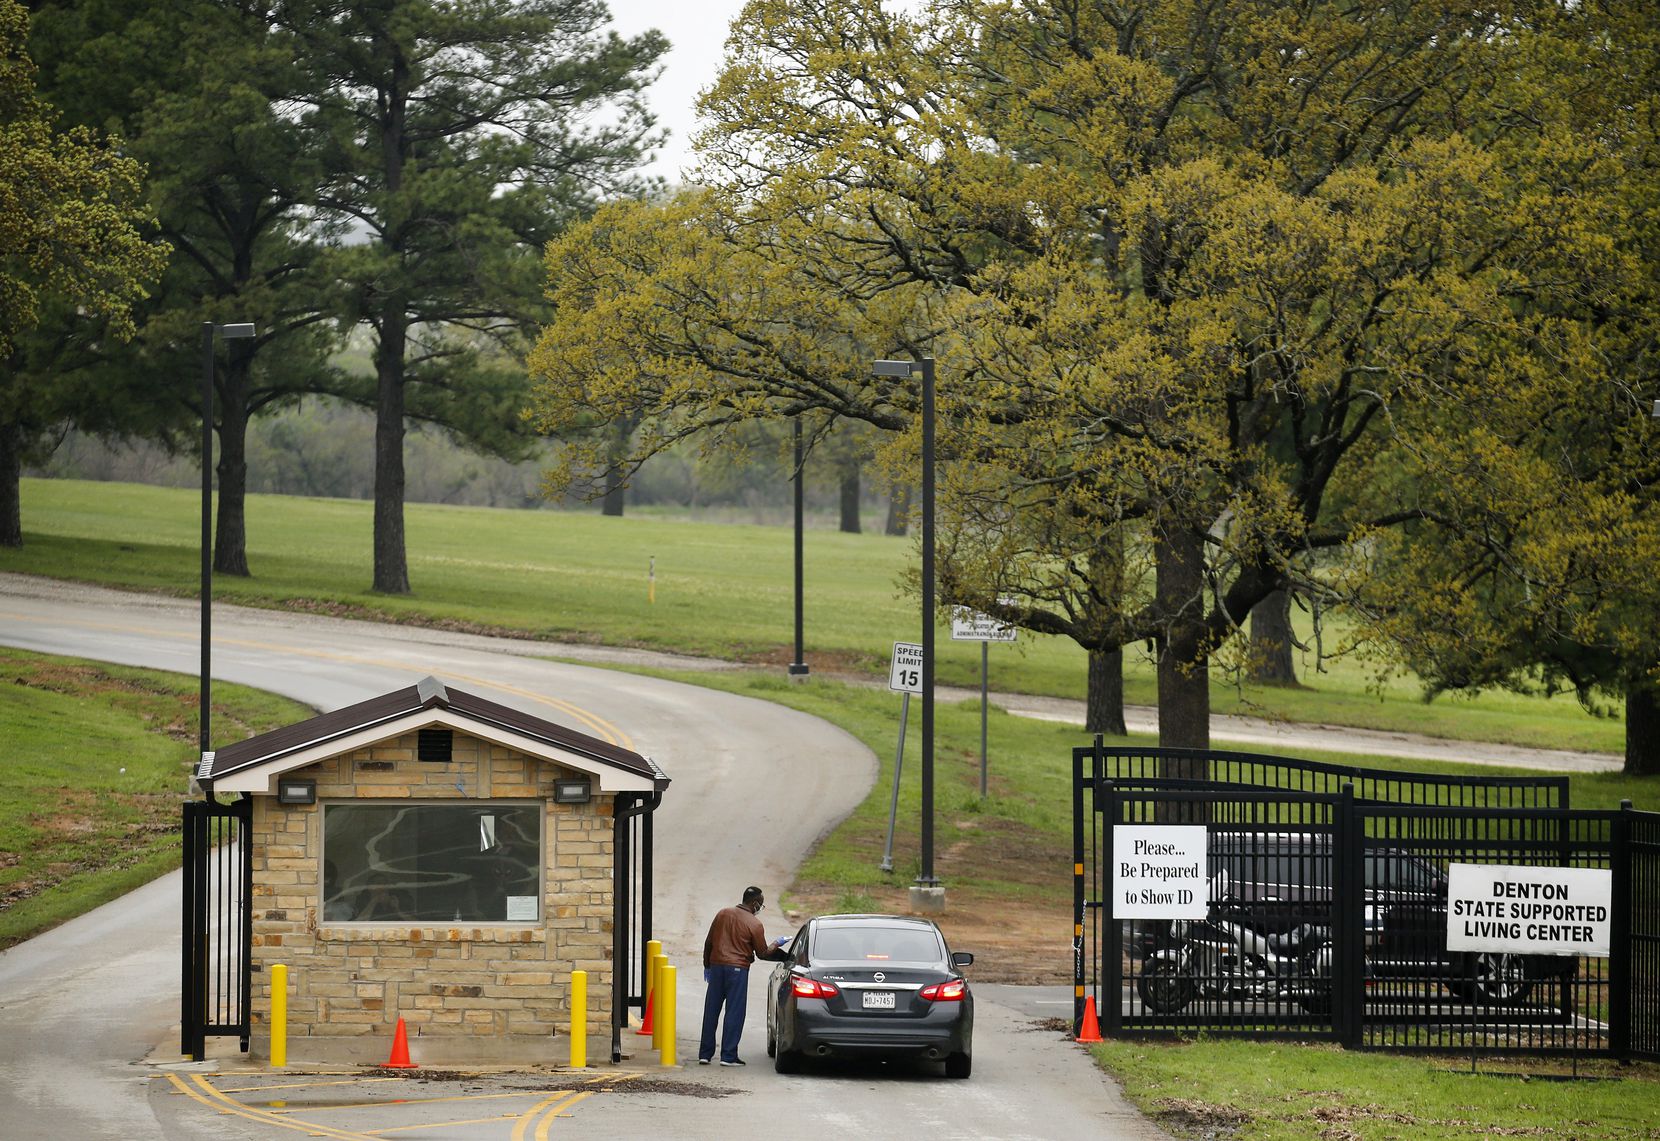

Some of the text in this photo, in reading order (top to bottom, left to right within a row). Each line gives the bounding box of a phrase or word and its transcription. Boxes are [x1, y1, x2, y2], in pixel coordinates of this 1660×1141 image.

[898, 657, 922, 666] LIMIT
[899, 669, 919, 686] 15
[1134, 840, 1185, 855] Please...
[1120, 862, 1199, 882] Be Prepared
[1125, 889, 1193, 904] to Show ID
[1493, 881, 1569, 900] DENTON
[1454, 899, 1607, 922] STATE SUPPORTED
[1464, 920, 1594, 942] LIVING CENTER
